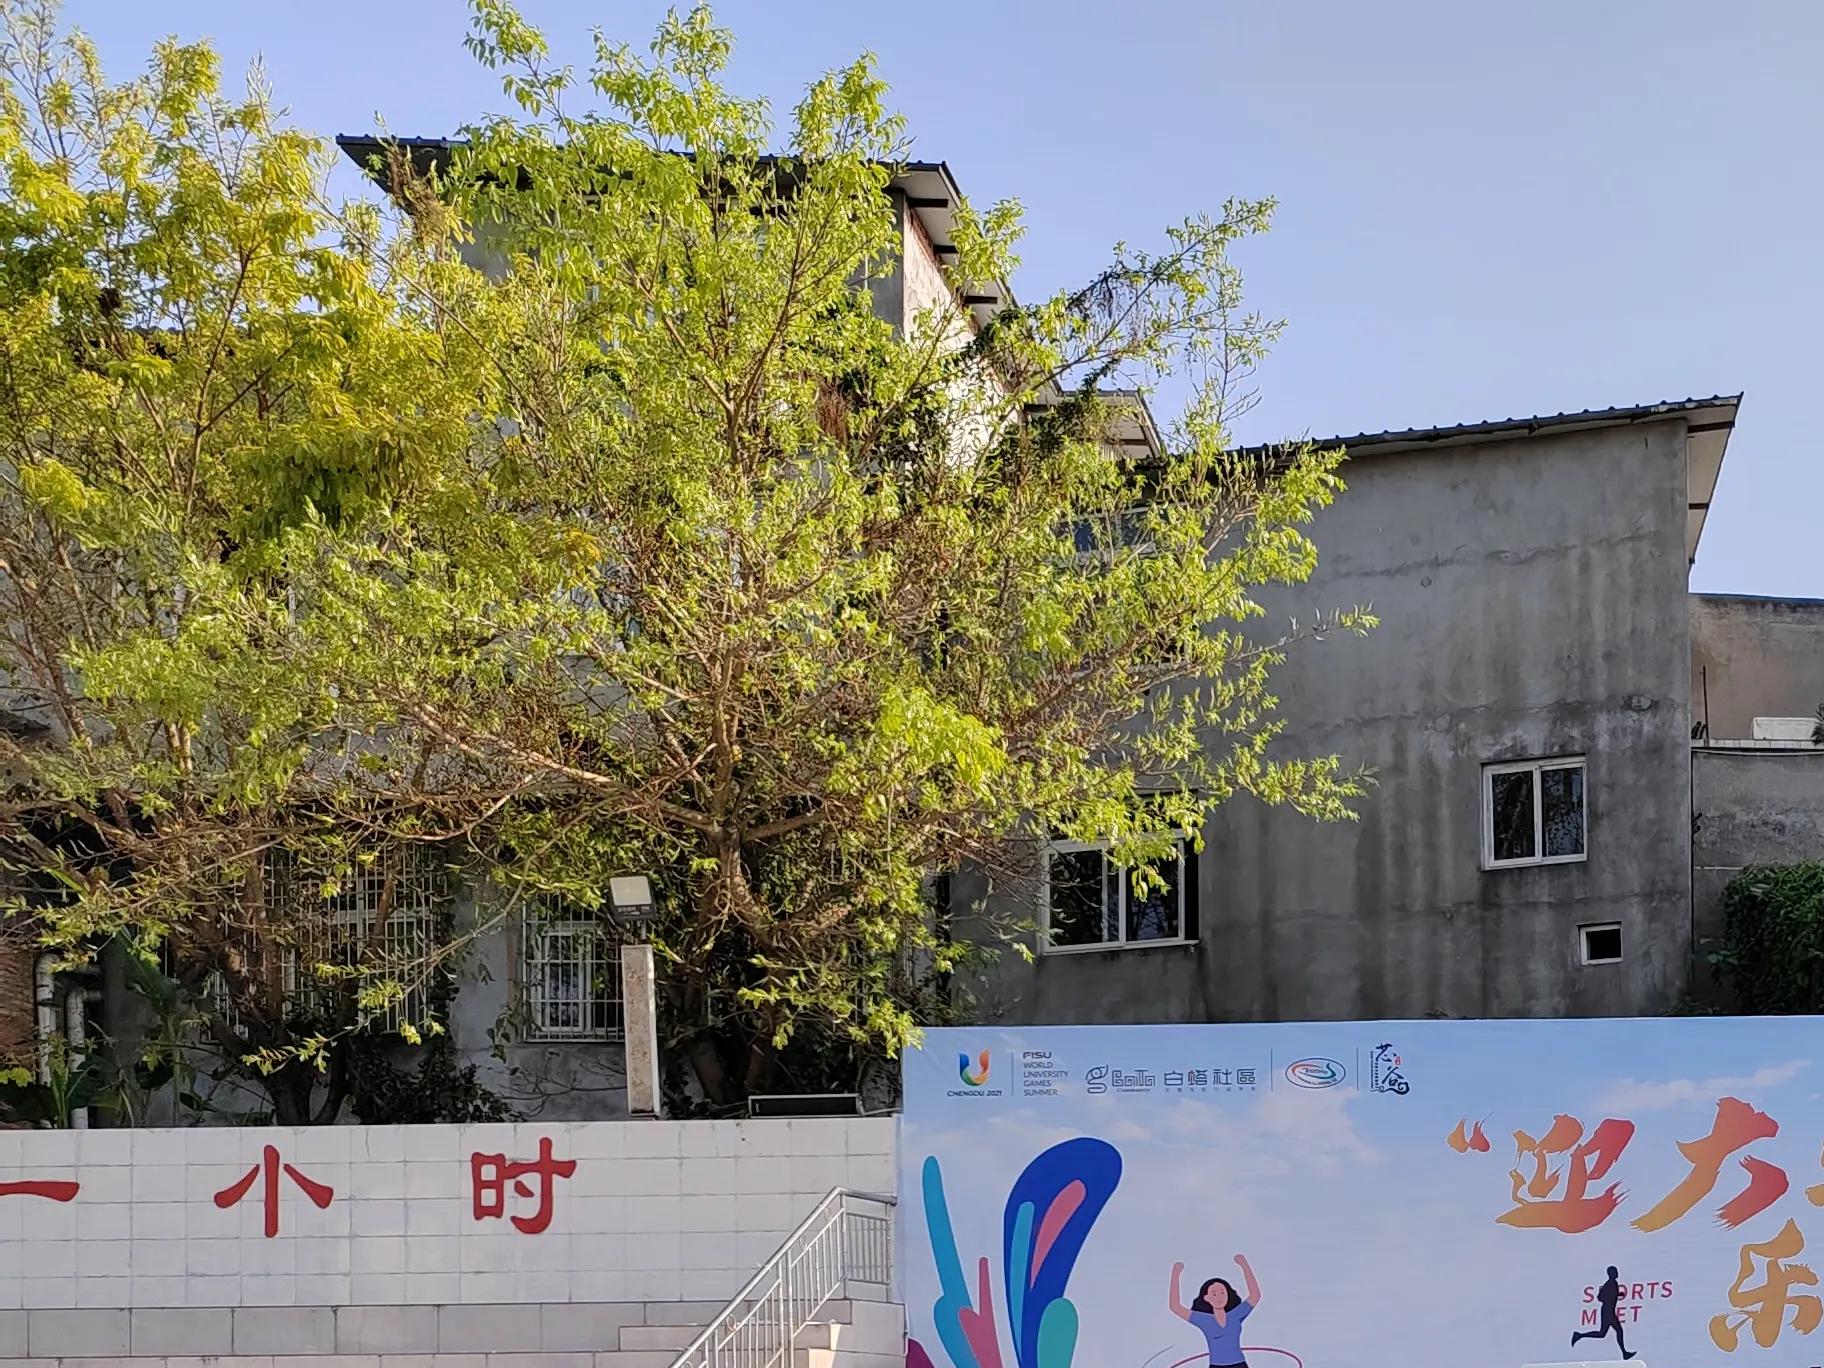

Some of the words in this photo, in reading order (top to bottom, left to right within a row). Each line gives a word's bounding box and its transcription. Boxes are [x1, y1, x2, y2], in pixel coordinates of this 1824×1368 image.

[1022, 1051, 1053, 1060] FISU
[1022, 1061, 1054, 1069] WORLD
[1022, 1070, 1070, 1079] UNIVERSITY
[1022, 1080, 1052, 1088] GAMES
[946, 1090, 985, 1098] CHENGDU
[985, 1090, 1003, 1098] 2021
[1022, 1088, 1059, 1097] SUMMER
[1582, 1280, 1674, 1304] SORTS
[1581, 1305, 1643, 1326] MET
